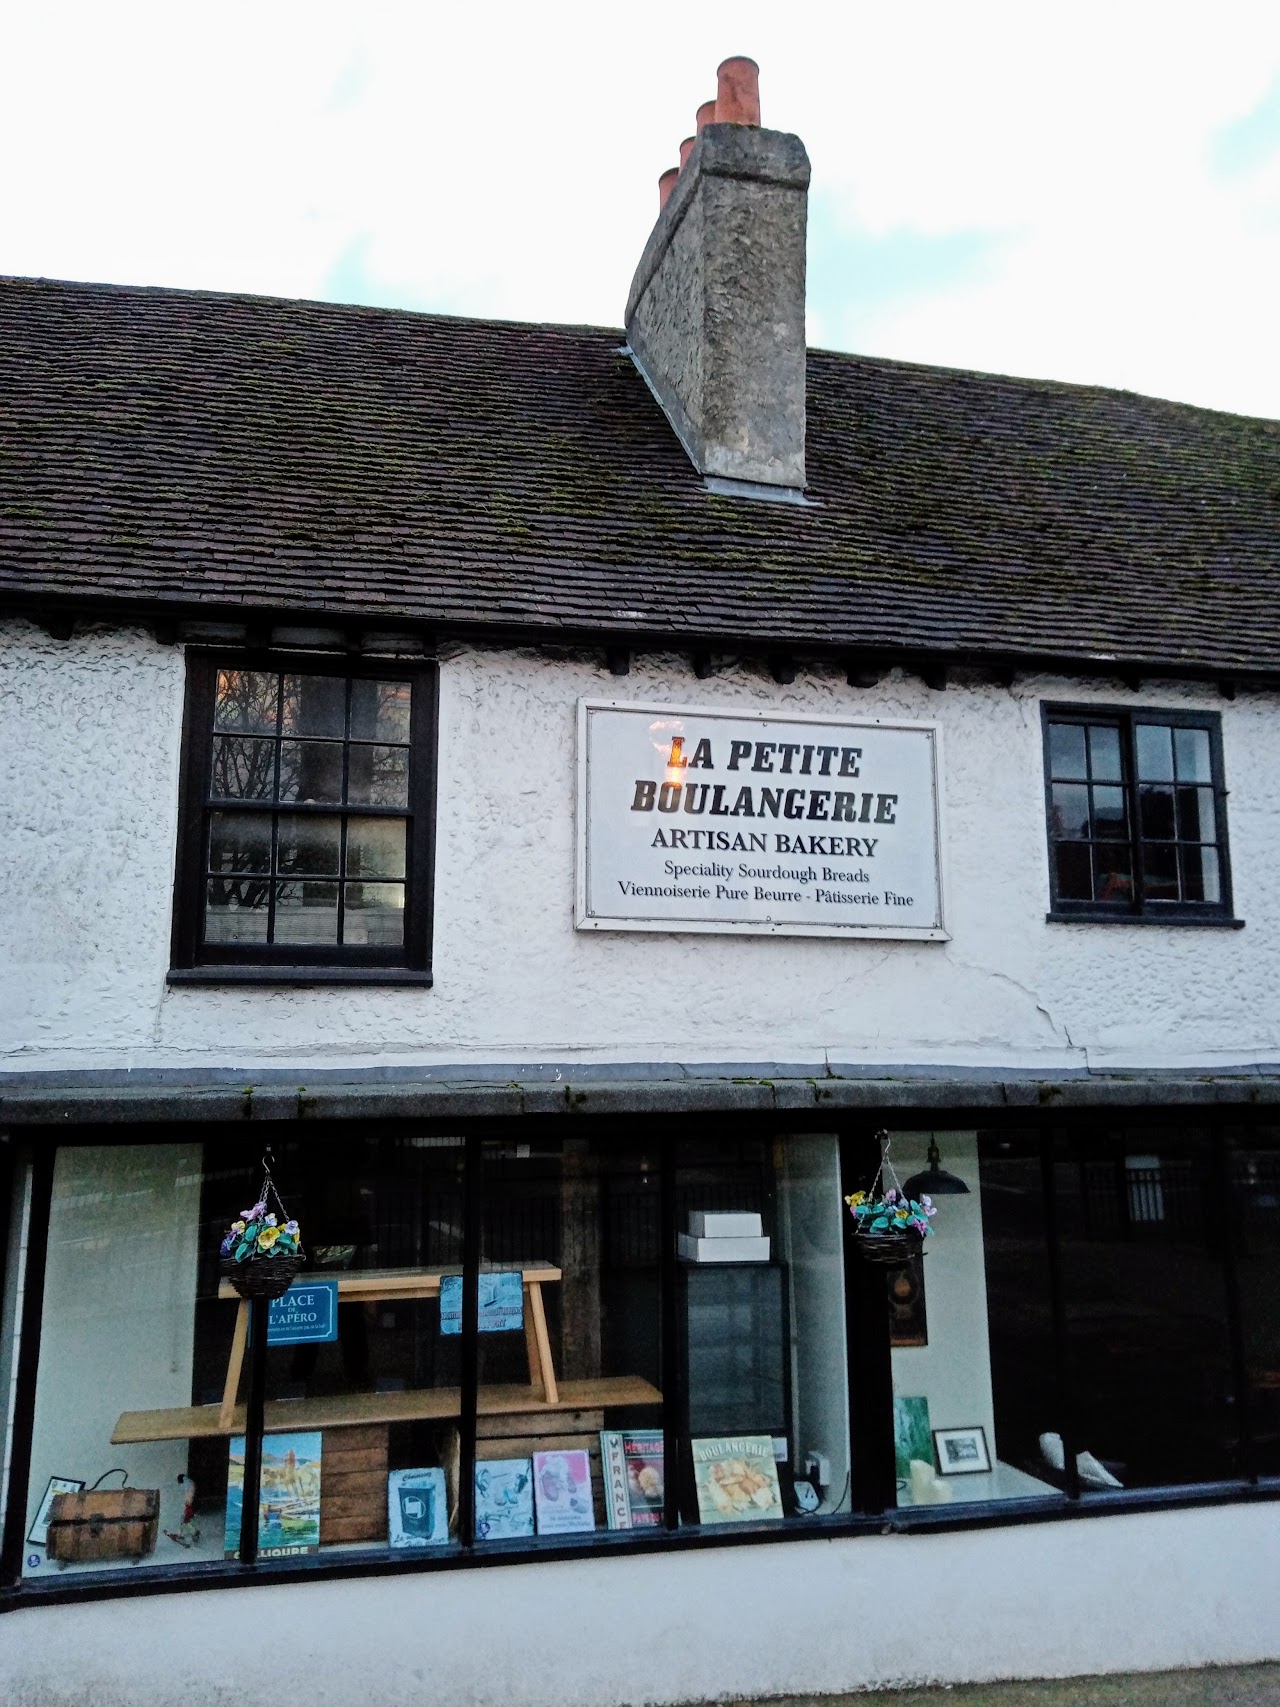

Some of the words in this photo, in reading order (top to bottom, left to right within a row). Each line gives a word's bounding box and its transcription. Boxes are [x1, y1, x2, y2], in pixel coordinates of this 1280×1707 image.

[667, 736, 714, 769] LA
[727, 740, 862, 778] PETITE
[631, 780, 898, 825] BOULANGERIE
[651, 828, 767, 852] ARTISAN
[774, 833, 878, 857] BAKERY
[664, 860, 733, 881] Speciality
[738, 863, 817, 884] Sourdough
[822, 867, 869, 882] Breads
[618, 880, 710, 899] Viennoiserie
[715, 884, 748, 900] Pure
[754, 886, 801, 902] Beurre
[815, 889, 879, 905] Pâtisserie
[883, 891, 914, 906] Fine
[271, 1294, 315, 1308] PLACE
[700, 1440, 770, 1461] BOULANGERIE
